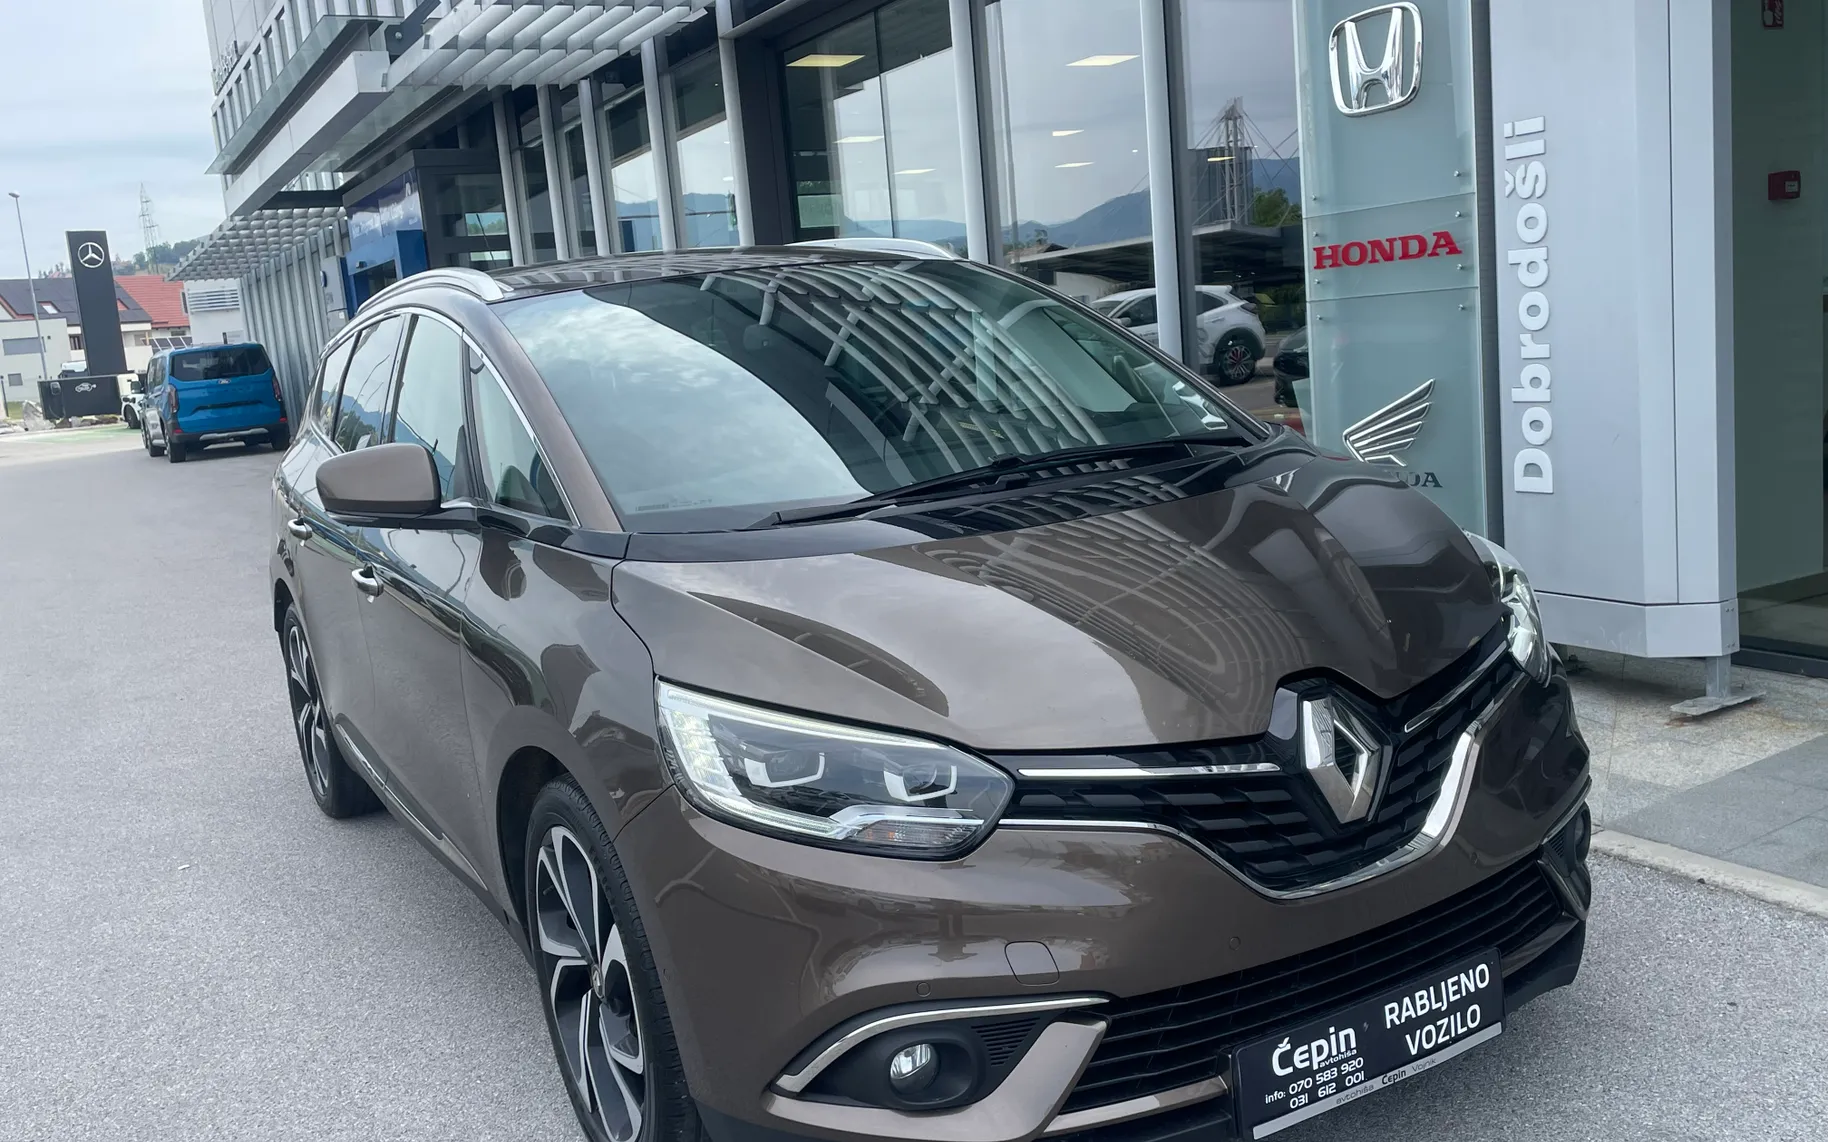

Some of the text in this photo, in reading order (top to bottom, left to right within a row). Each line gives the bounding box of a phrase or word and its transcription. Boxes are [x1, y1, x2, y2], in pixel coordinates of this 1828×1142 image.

[1312, 230, 1463, 270] HONDA
[1503, 115, 1554, 494] Dobrodošli
[1384, 963, 1490, 1030] RABLJENO
[1272, 1026, 1357, 1077] Čepin
[1405, 1003, 1481, 1056] VOZILO
[1265, 1057, 1364, 1104] info: 070 583 920
[1319, 1049, 1357, 1068] avtohiša
[1289, 1071, 1365, 1109] 031 612 001
[1336, 1084, 1374, 1105] avtohiša
